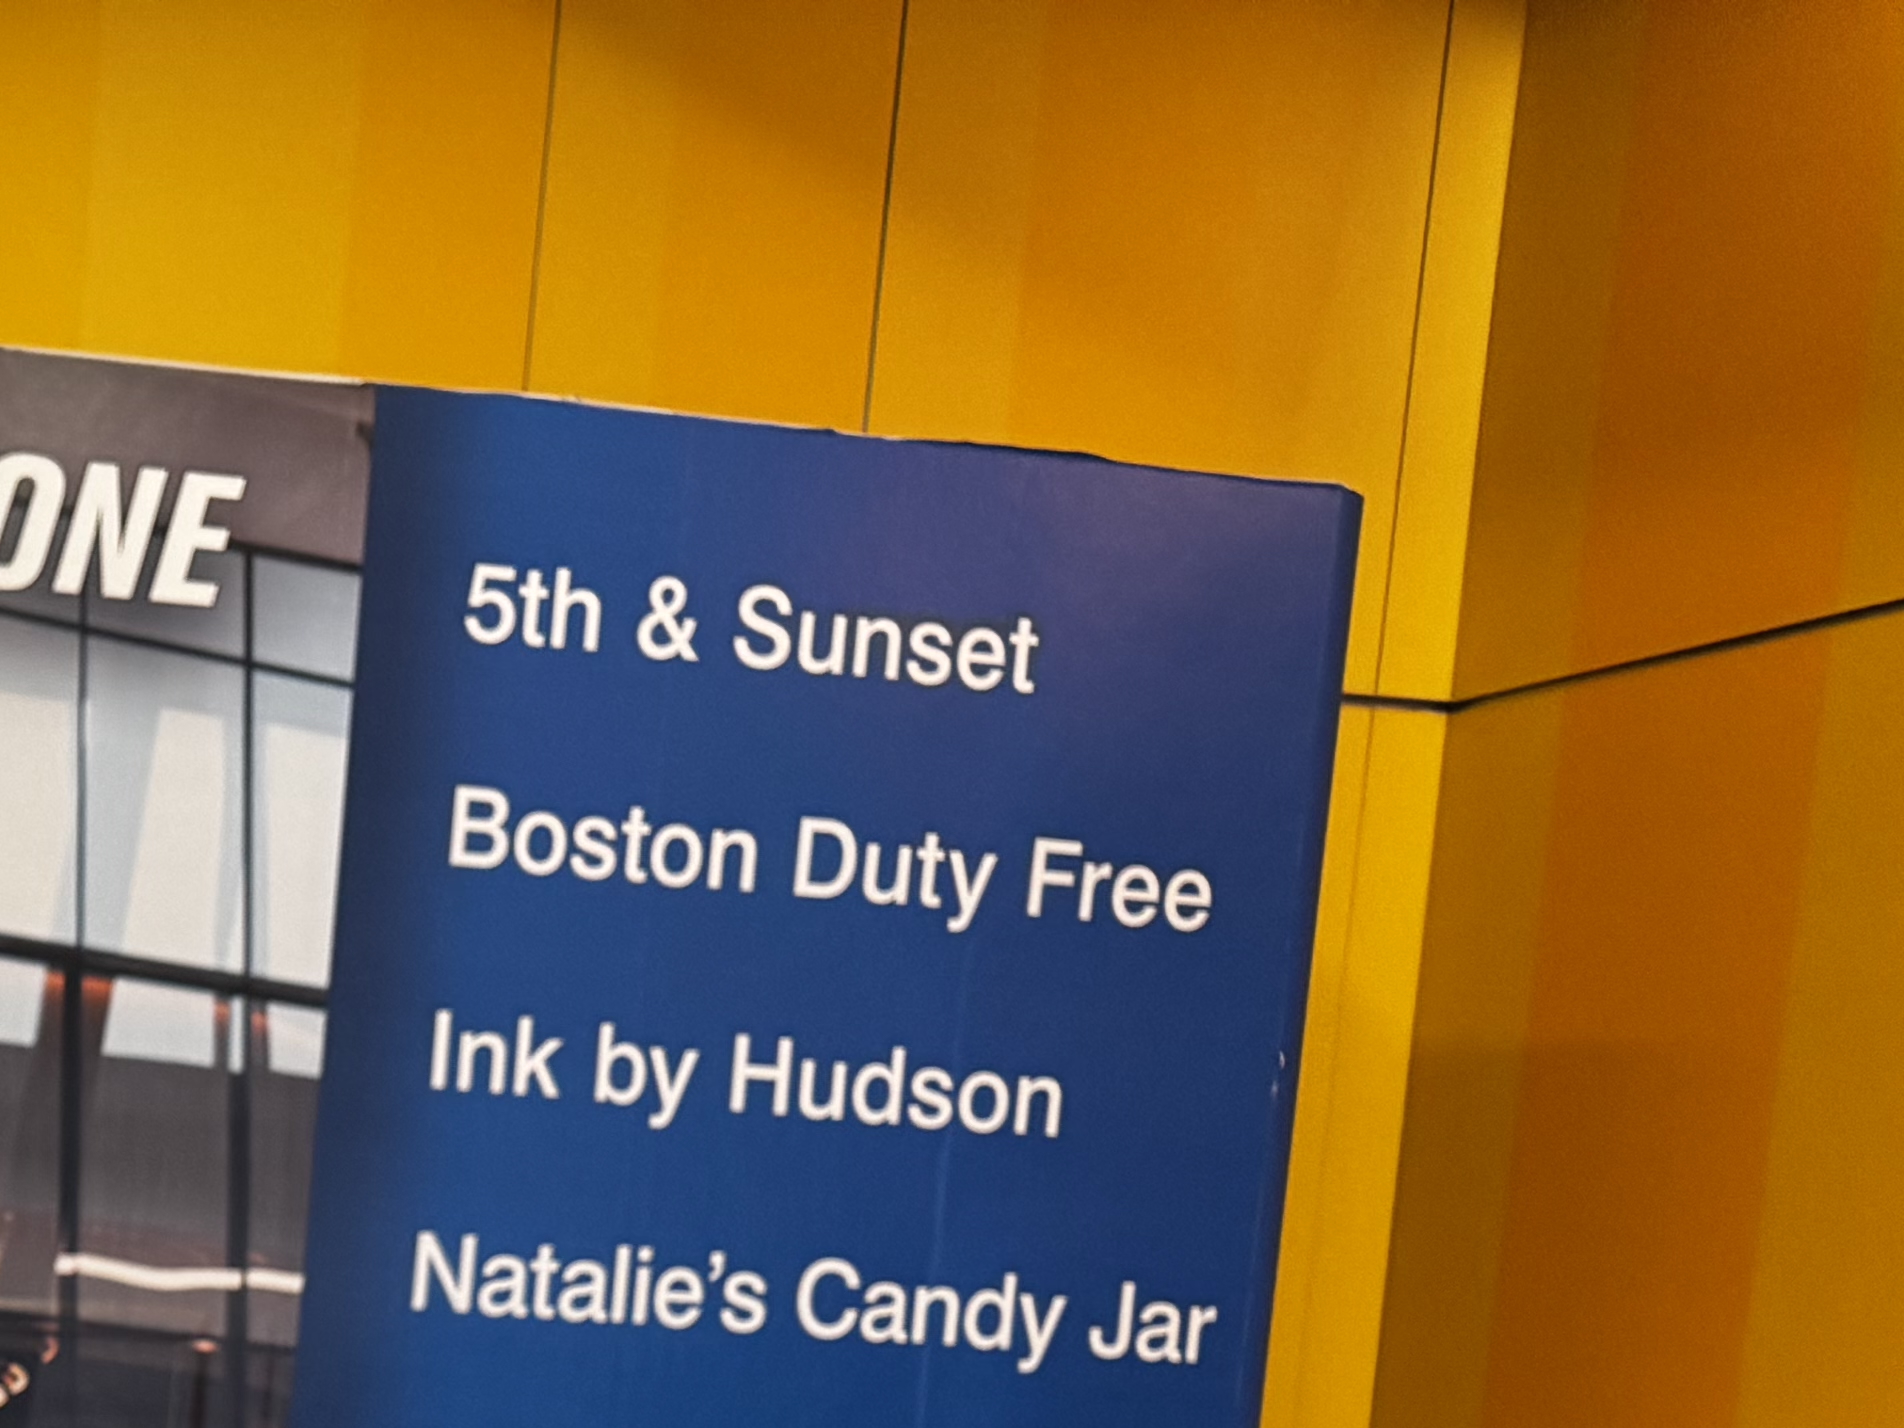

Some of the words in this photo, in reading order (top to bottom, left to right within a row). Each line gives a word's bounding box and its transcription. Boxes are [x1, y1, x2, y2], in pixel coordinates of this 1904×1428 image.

[466, 565, 600, 651] 5th
[638, 577, 697, 660] &
[735, 586, 1038, 692] Sunset
[450, 787, 756, 891] Boston
[795, 818, 996, 931] Duty
[1028, 840, 1210, 930] Free
[432, 1011, 560, 1097] Ink
[596, 1024, 697, 1127] by
[731, 1035, 1060, 1136] Hudson
[412, 1233, 765, 1332] Natalie’s
[798, 1260, 1065, 1371] Candy
[1090, 1284, 1216, 1361] Jar
